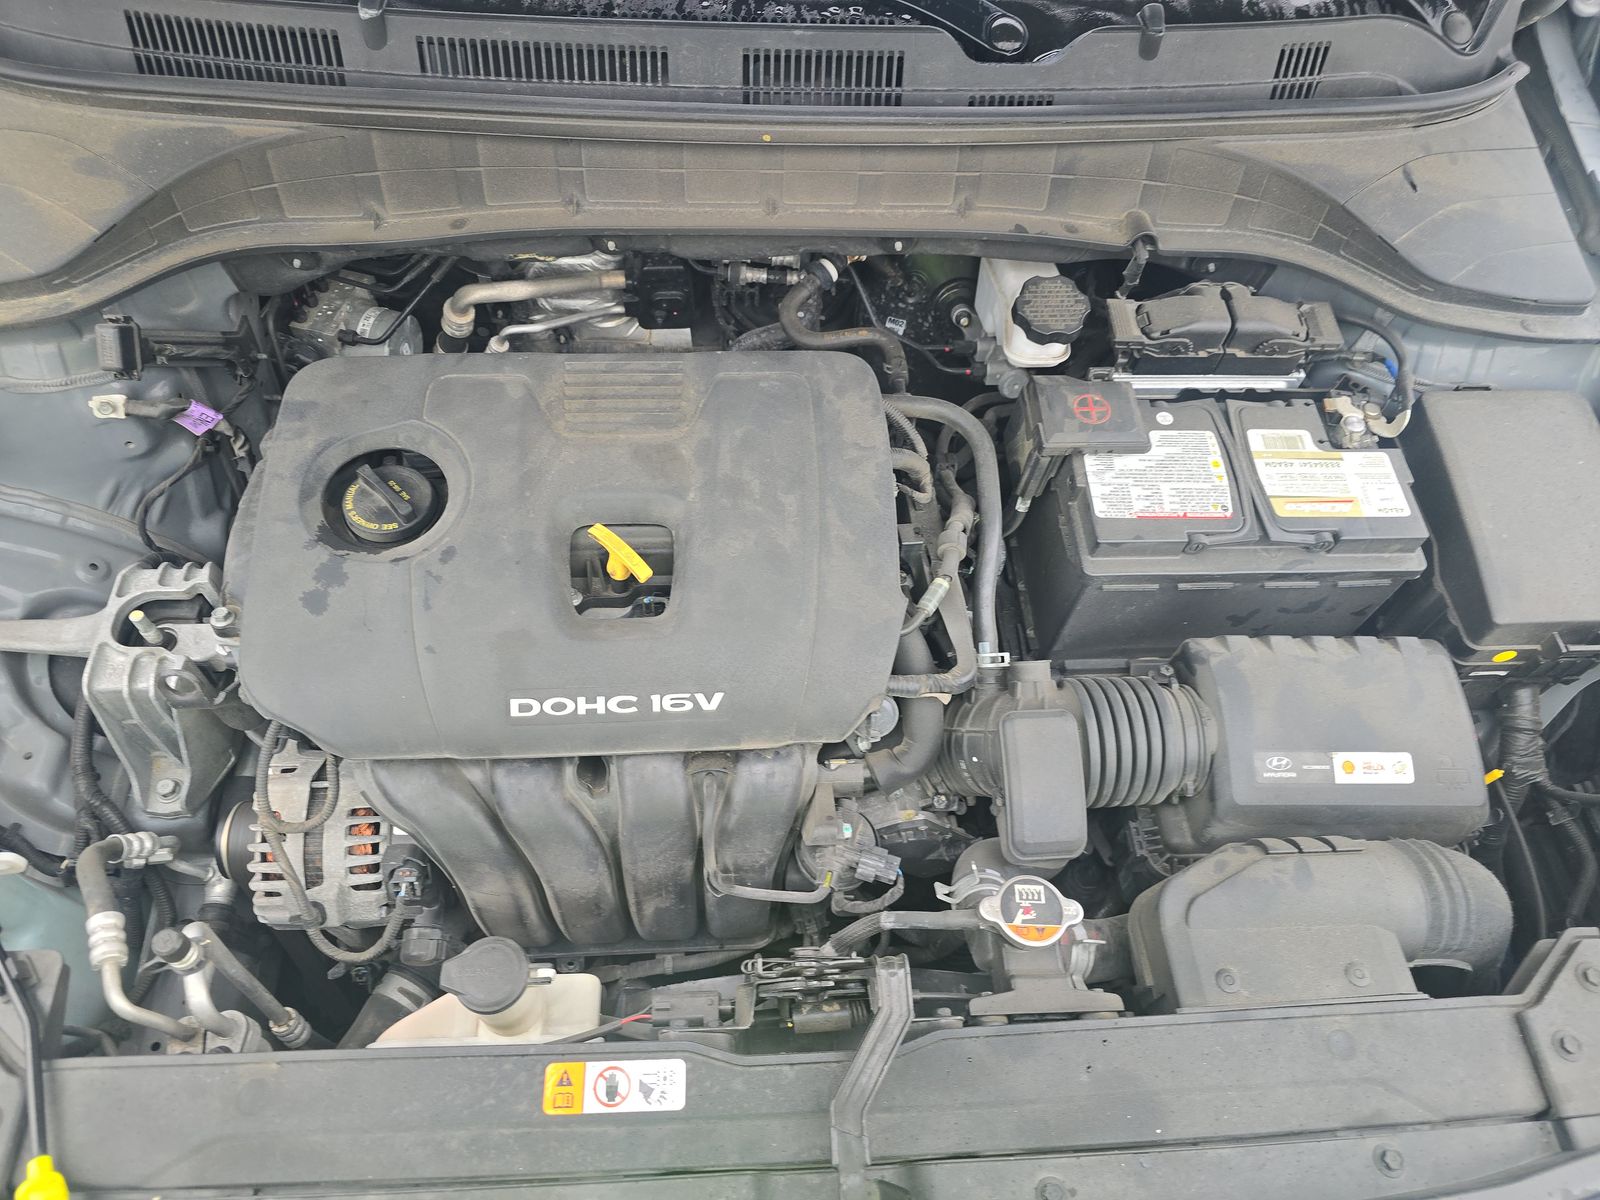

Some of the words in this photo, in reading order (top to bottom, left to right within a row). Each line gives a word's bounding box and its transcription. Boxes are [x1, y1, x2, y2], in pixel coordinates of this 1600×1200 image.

[344, 484, 360, 510] MANUAL
[381, 522, 399, 531] SEE
[509, 695, 639, 717] DOHC
[650, 692, 725, 713] 16V
